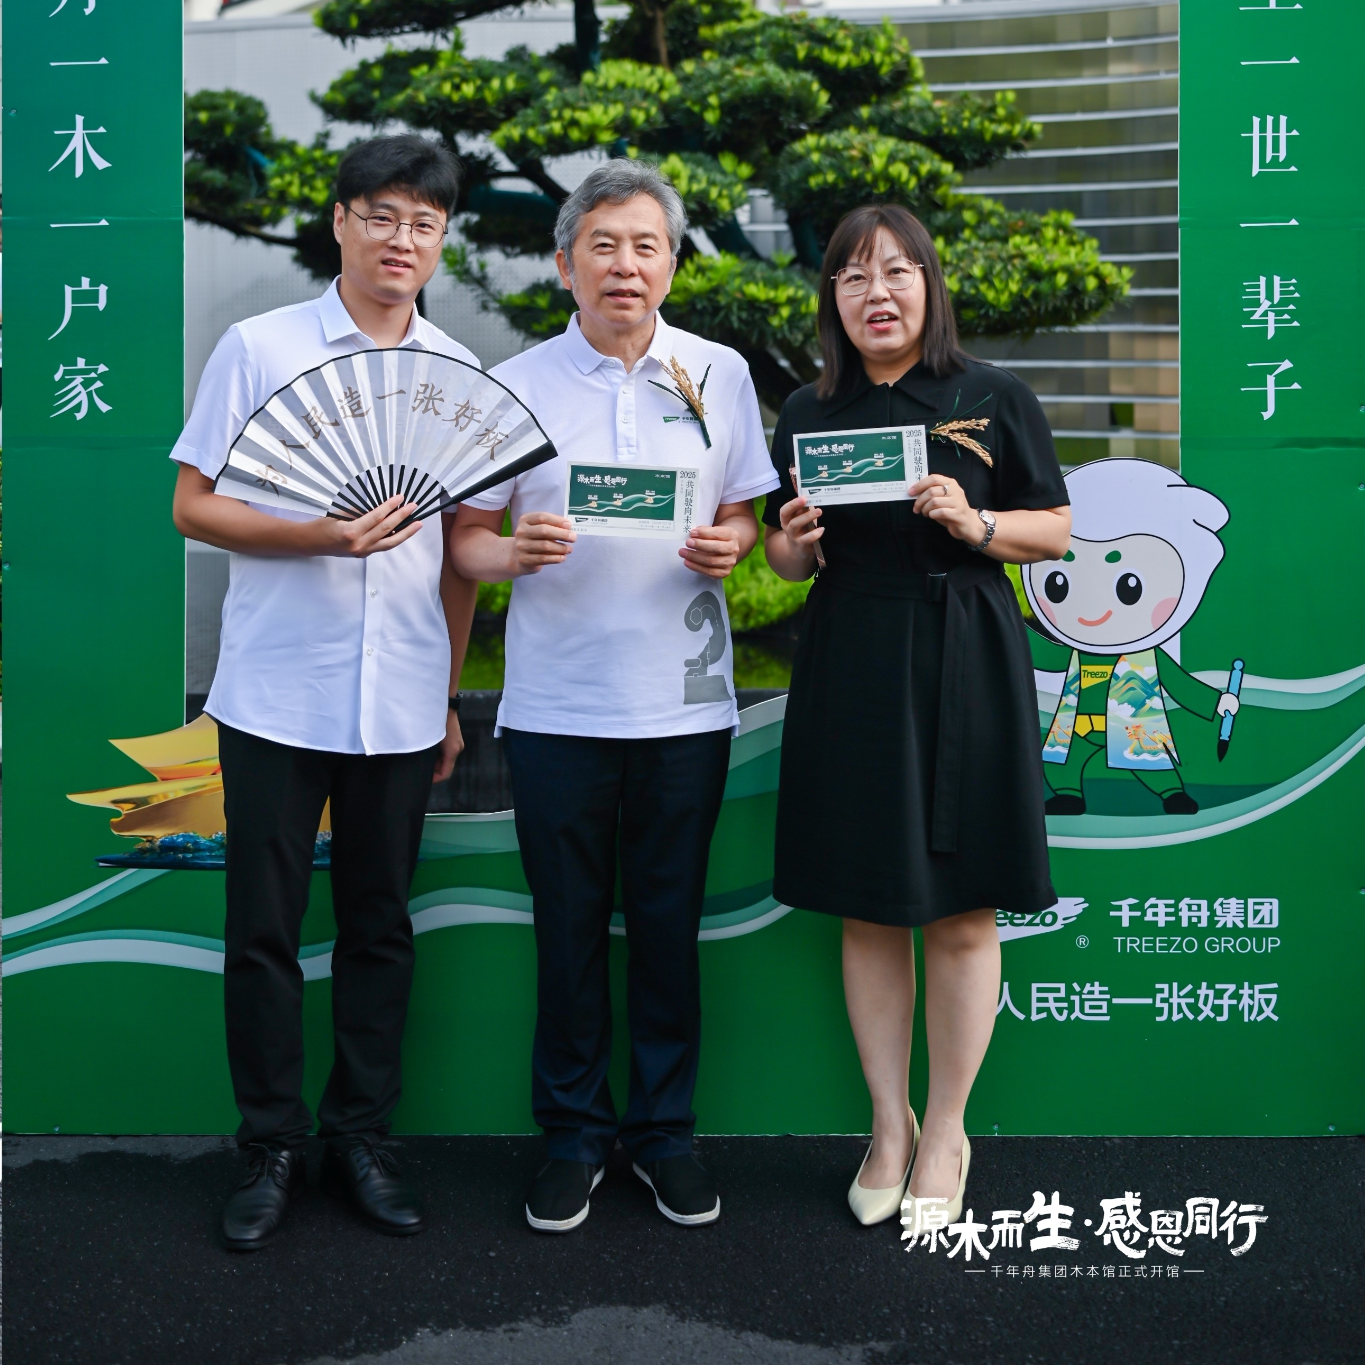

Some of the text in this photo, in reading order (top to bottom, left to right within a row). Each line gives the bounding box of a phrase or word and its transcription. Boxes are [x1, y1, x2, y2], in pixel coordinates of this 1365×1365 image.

[995, 909, 1059, 928] eezo
[1109, 897, 1280, 929] 千年舟集团
[1113, 936, 1281, 955] TREEZO GROUP
[996, 981, 1280, 1023] 人民造一张好板
